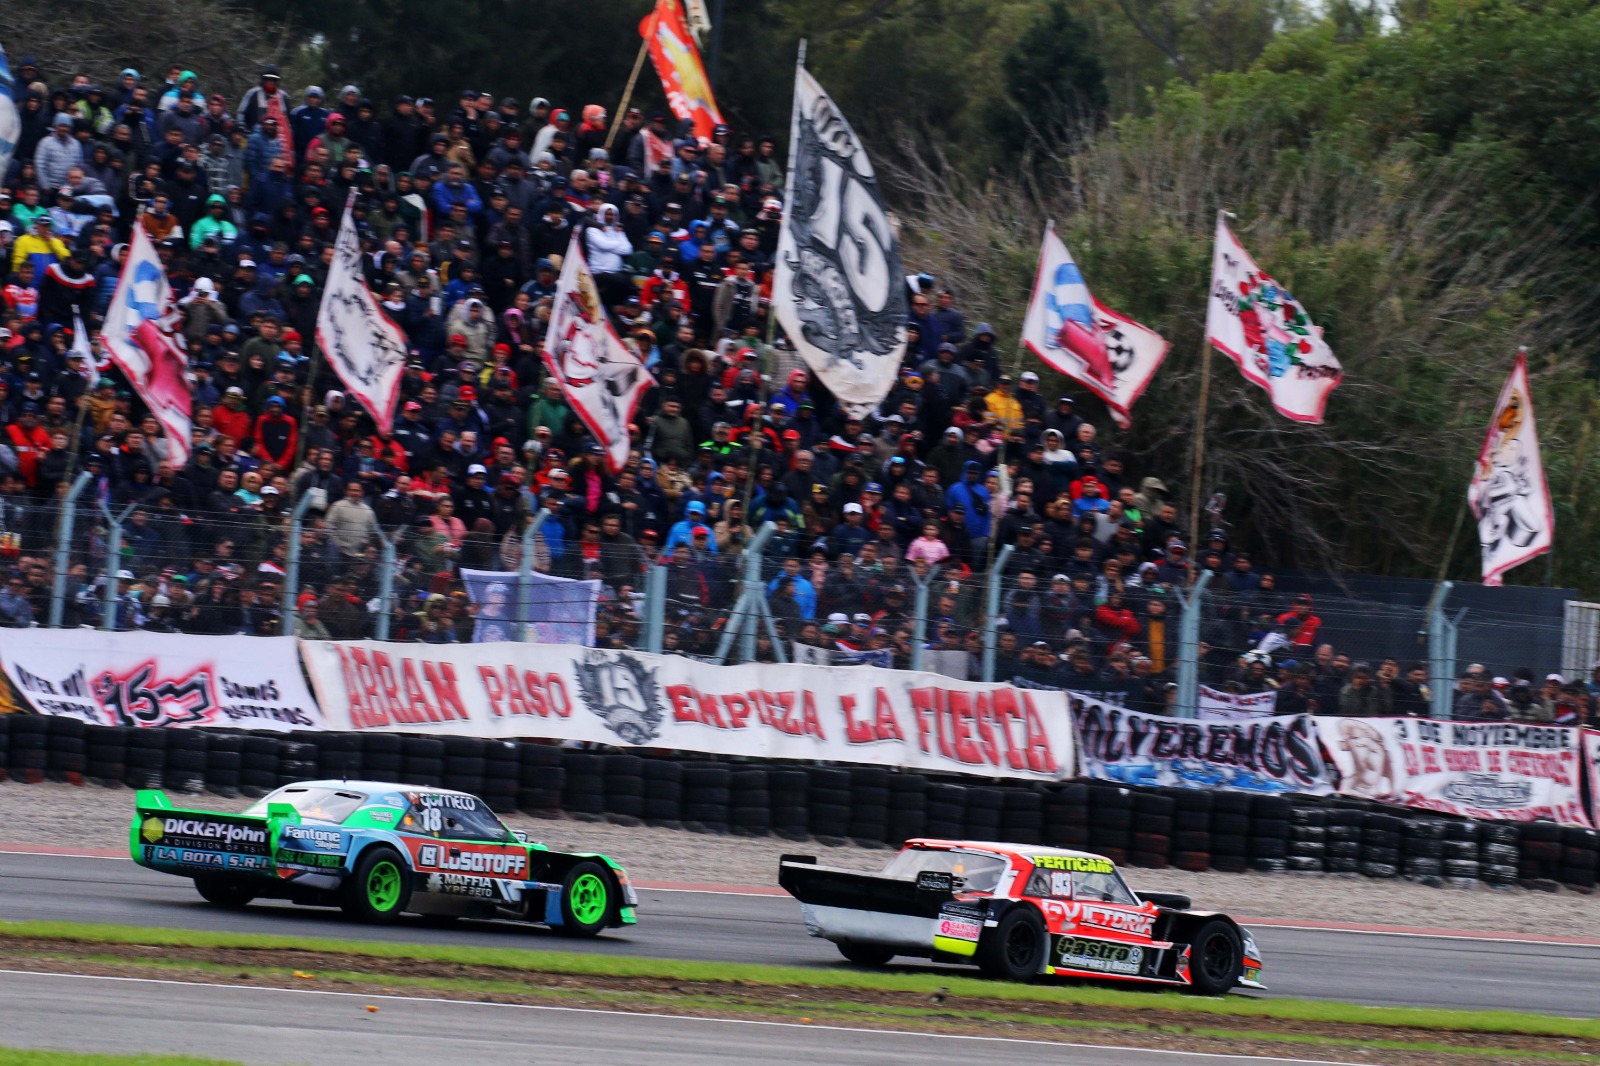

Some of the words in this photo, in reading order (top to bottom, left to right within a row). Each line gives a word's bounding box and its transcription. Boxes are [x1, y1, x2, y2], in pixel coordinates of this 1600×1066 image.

[333, 643, 470, 728] ABRAN
[478, 665, 573, 718] PASO
[840, 687, 904, 745] LA
[910, 686, 1058, 774] FIESTA
[1418, 721, 1441, 743] DE
[1452, 724, 1571, 749] NOVIEMBRE
[422, 807, 442, 831] 18
[285, 826, 340, 842] Fantone
[225, 844, 239, 852] OF
[157, 848, 177, 860] LA
[182, 851, 223, 865] BOTA
[444, 874, 492, 888] MAFFIA
[468, 887, 493, 897] agro
[949, 929, 978, 939] SEGUROS
